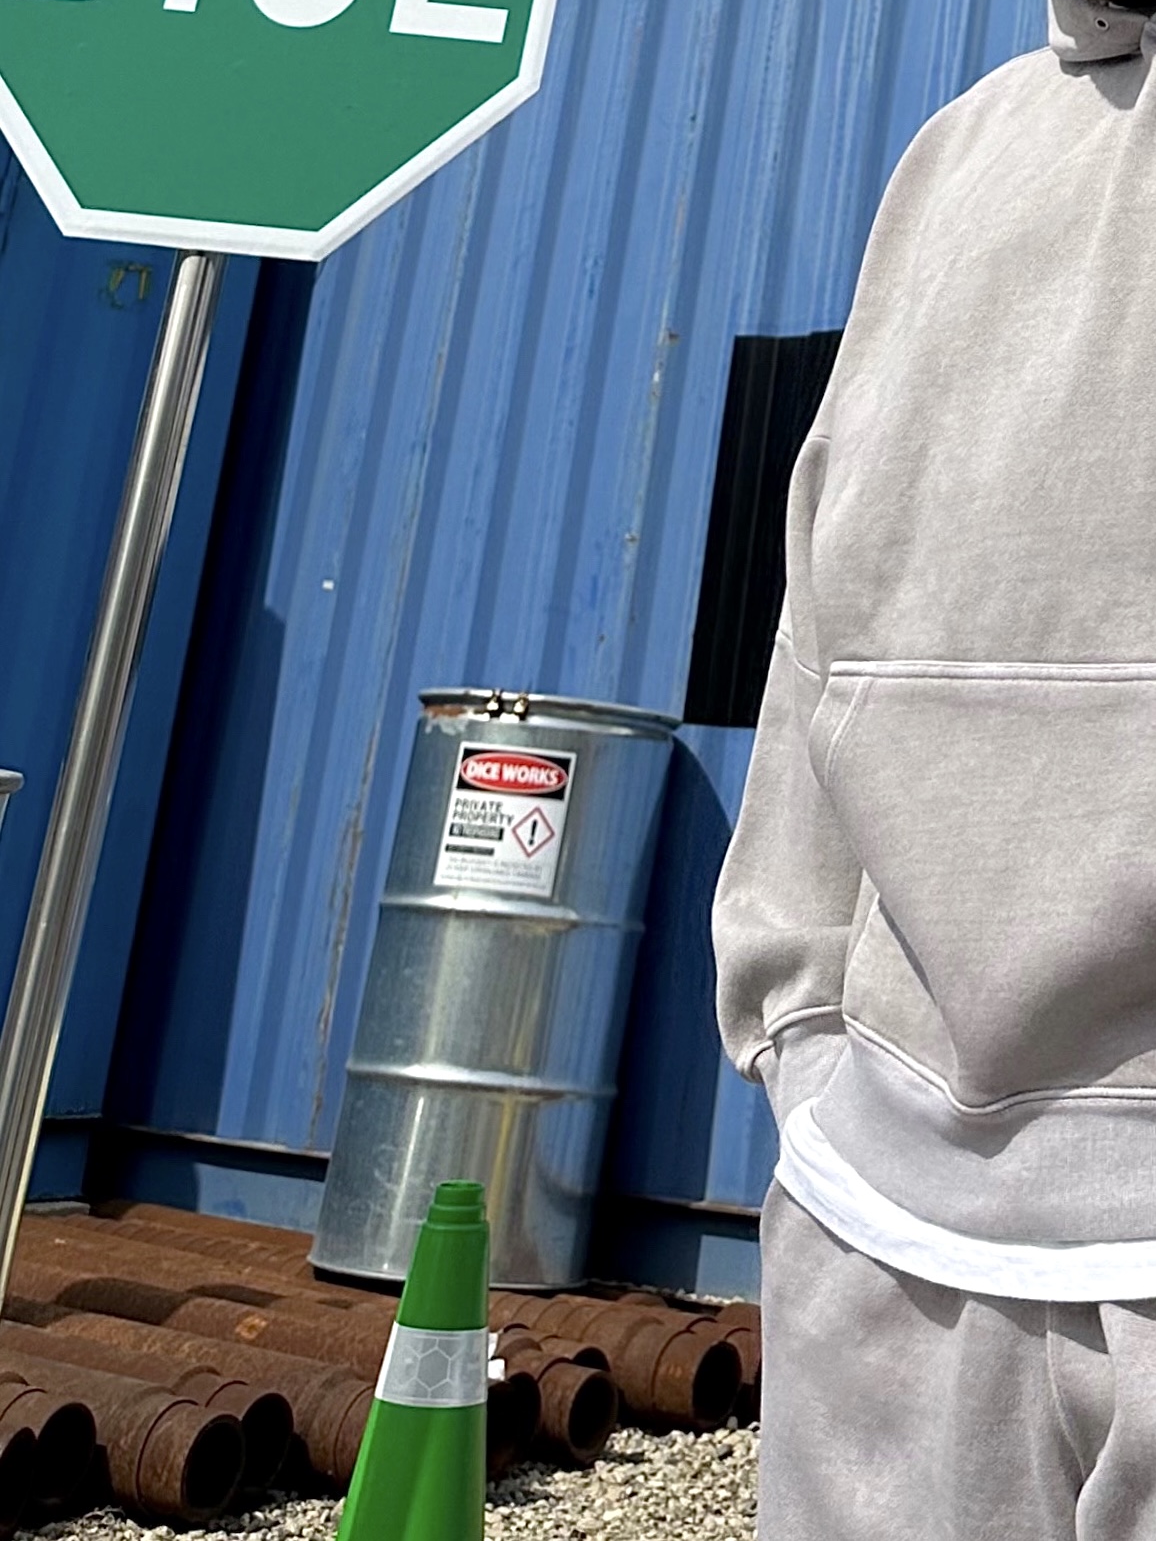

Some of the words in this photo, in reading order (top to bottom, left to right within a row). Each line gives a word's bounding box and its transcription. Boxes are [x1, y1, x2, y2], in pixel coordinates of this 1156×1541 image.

[466, 760, 501, 781] DICE
[502, 763, 559, 786] WORKS
[455, 797, 503, 813] PRIVATE
[453, 809, 515, 826] PROPERTY
